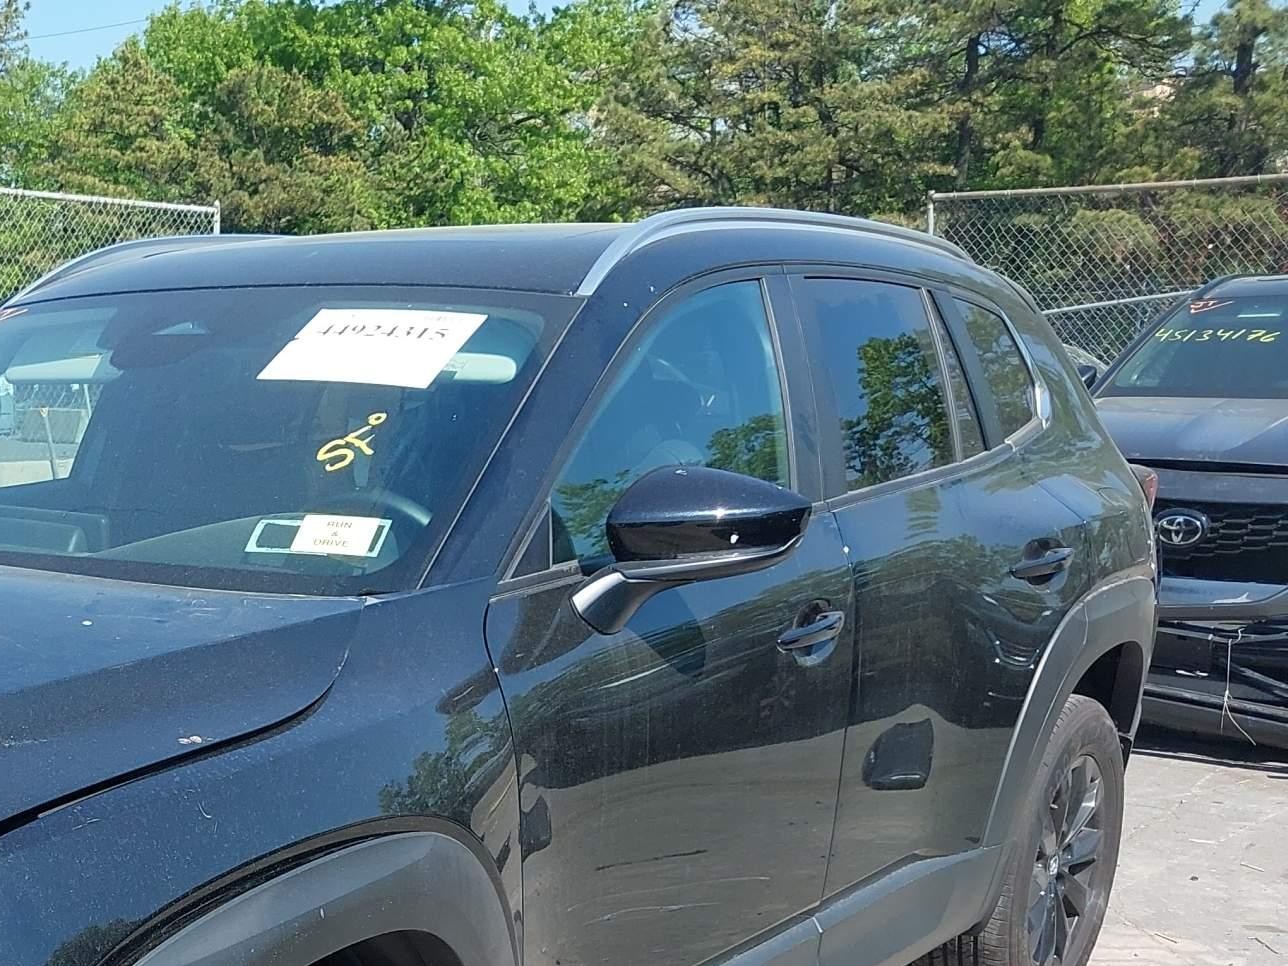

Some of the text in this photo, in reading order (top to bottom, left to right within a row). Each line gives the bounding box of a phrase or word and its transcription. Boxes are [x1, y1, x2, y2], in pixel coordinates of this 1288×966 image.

[1155, 328, 1281, 342] 45134176
[326, 520, 353, 529] RUN
[313, 538, 351, 548] DRIVE
